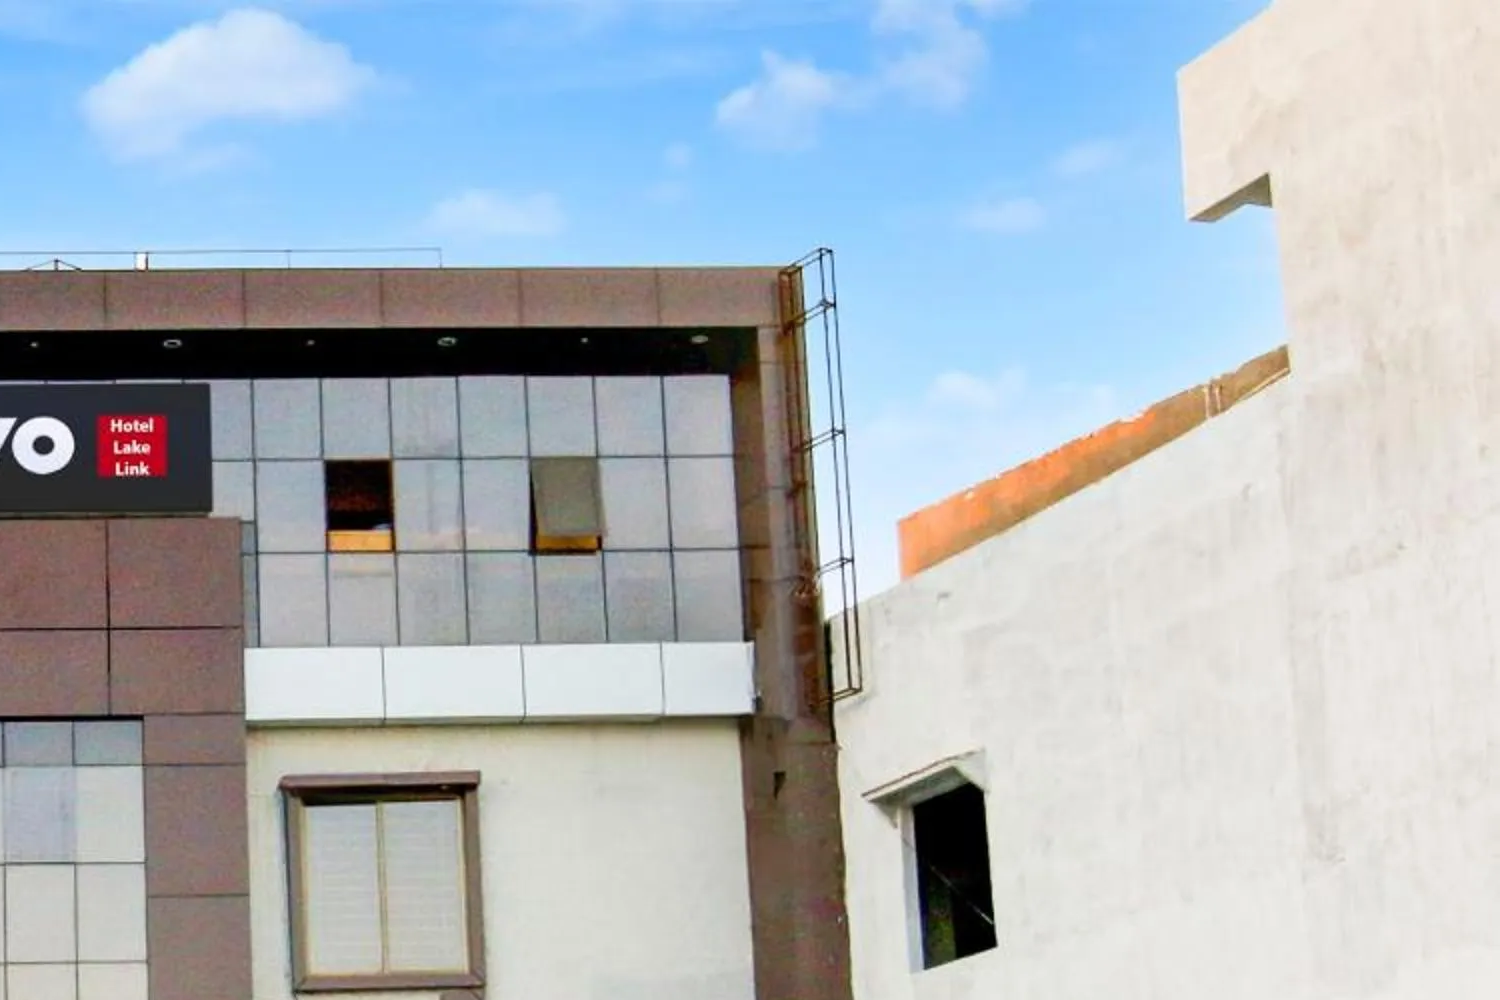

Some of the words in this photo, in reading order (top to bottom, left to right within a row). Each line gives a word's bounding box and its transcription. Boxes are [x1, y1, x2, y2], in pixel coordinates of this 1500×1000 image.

[109, 418, 155, 433] Hotel
[112, 439, 152, 455] Lake
[114, 461, 151, 477] Link
